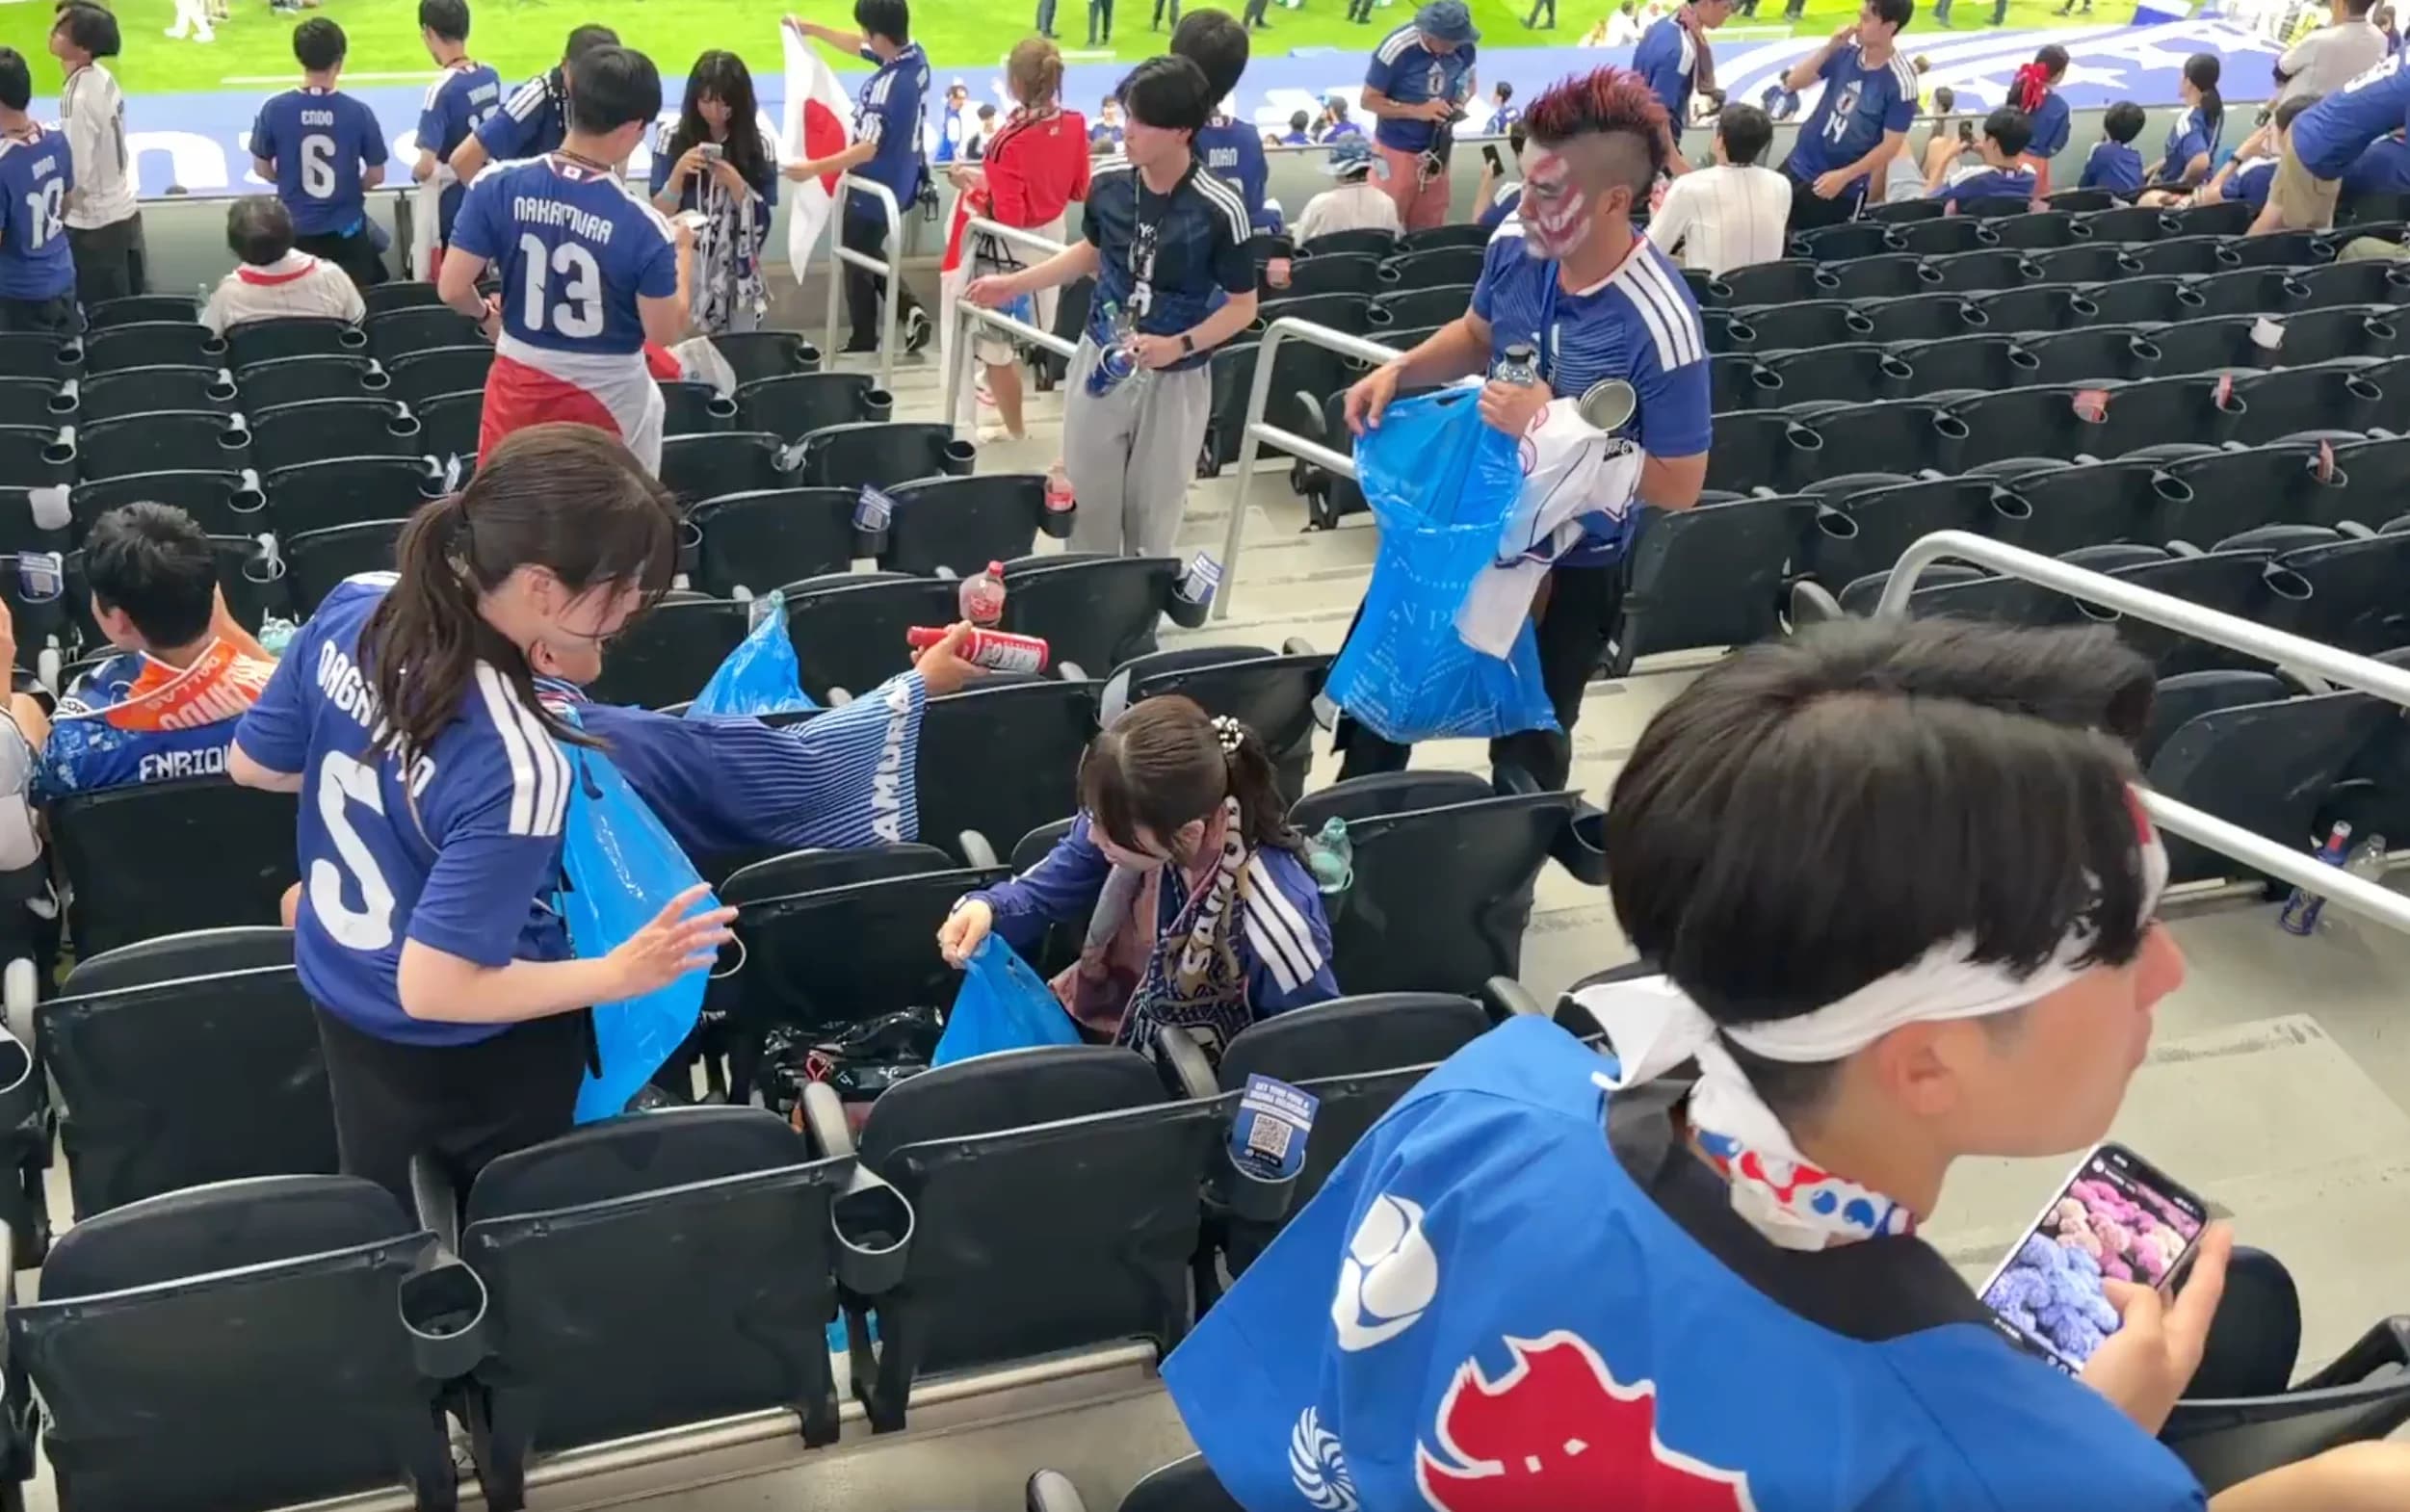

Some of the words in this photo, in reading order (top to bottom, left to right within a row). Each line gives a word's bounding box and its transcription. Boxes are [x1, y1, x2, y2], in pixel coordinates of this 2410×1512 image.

[301, 110, 333, 126] ENDO
[1821, 110, 1848, 144] 14
[301, 134, 336, 198] 6
[513, 196, 614, 245] NAKAMURA
[519, 232, 604, 338] 13
[139, 744, 229, 782] ENRIQ
[309, 749, 396, 952] 5
